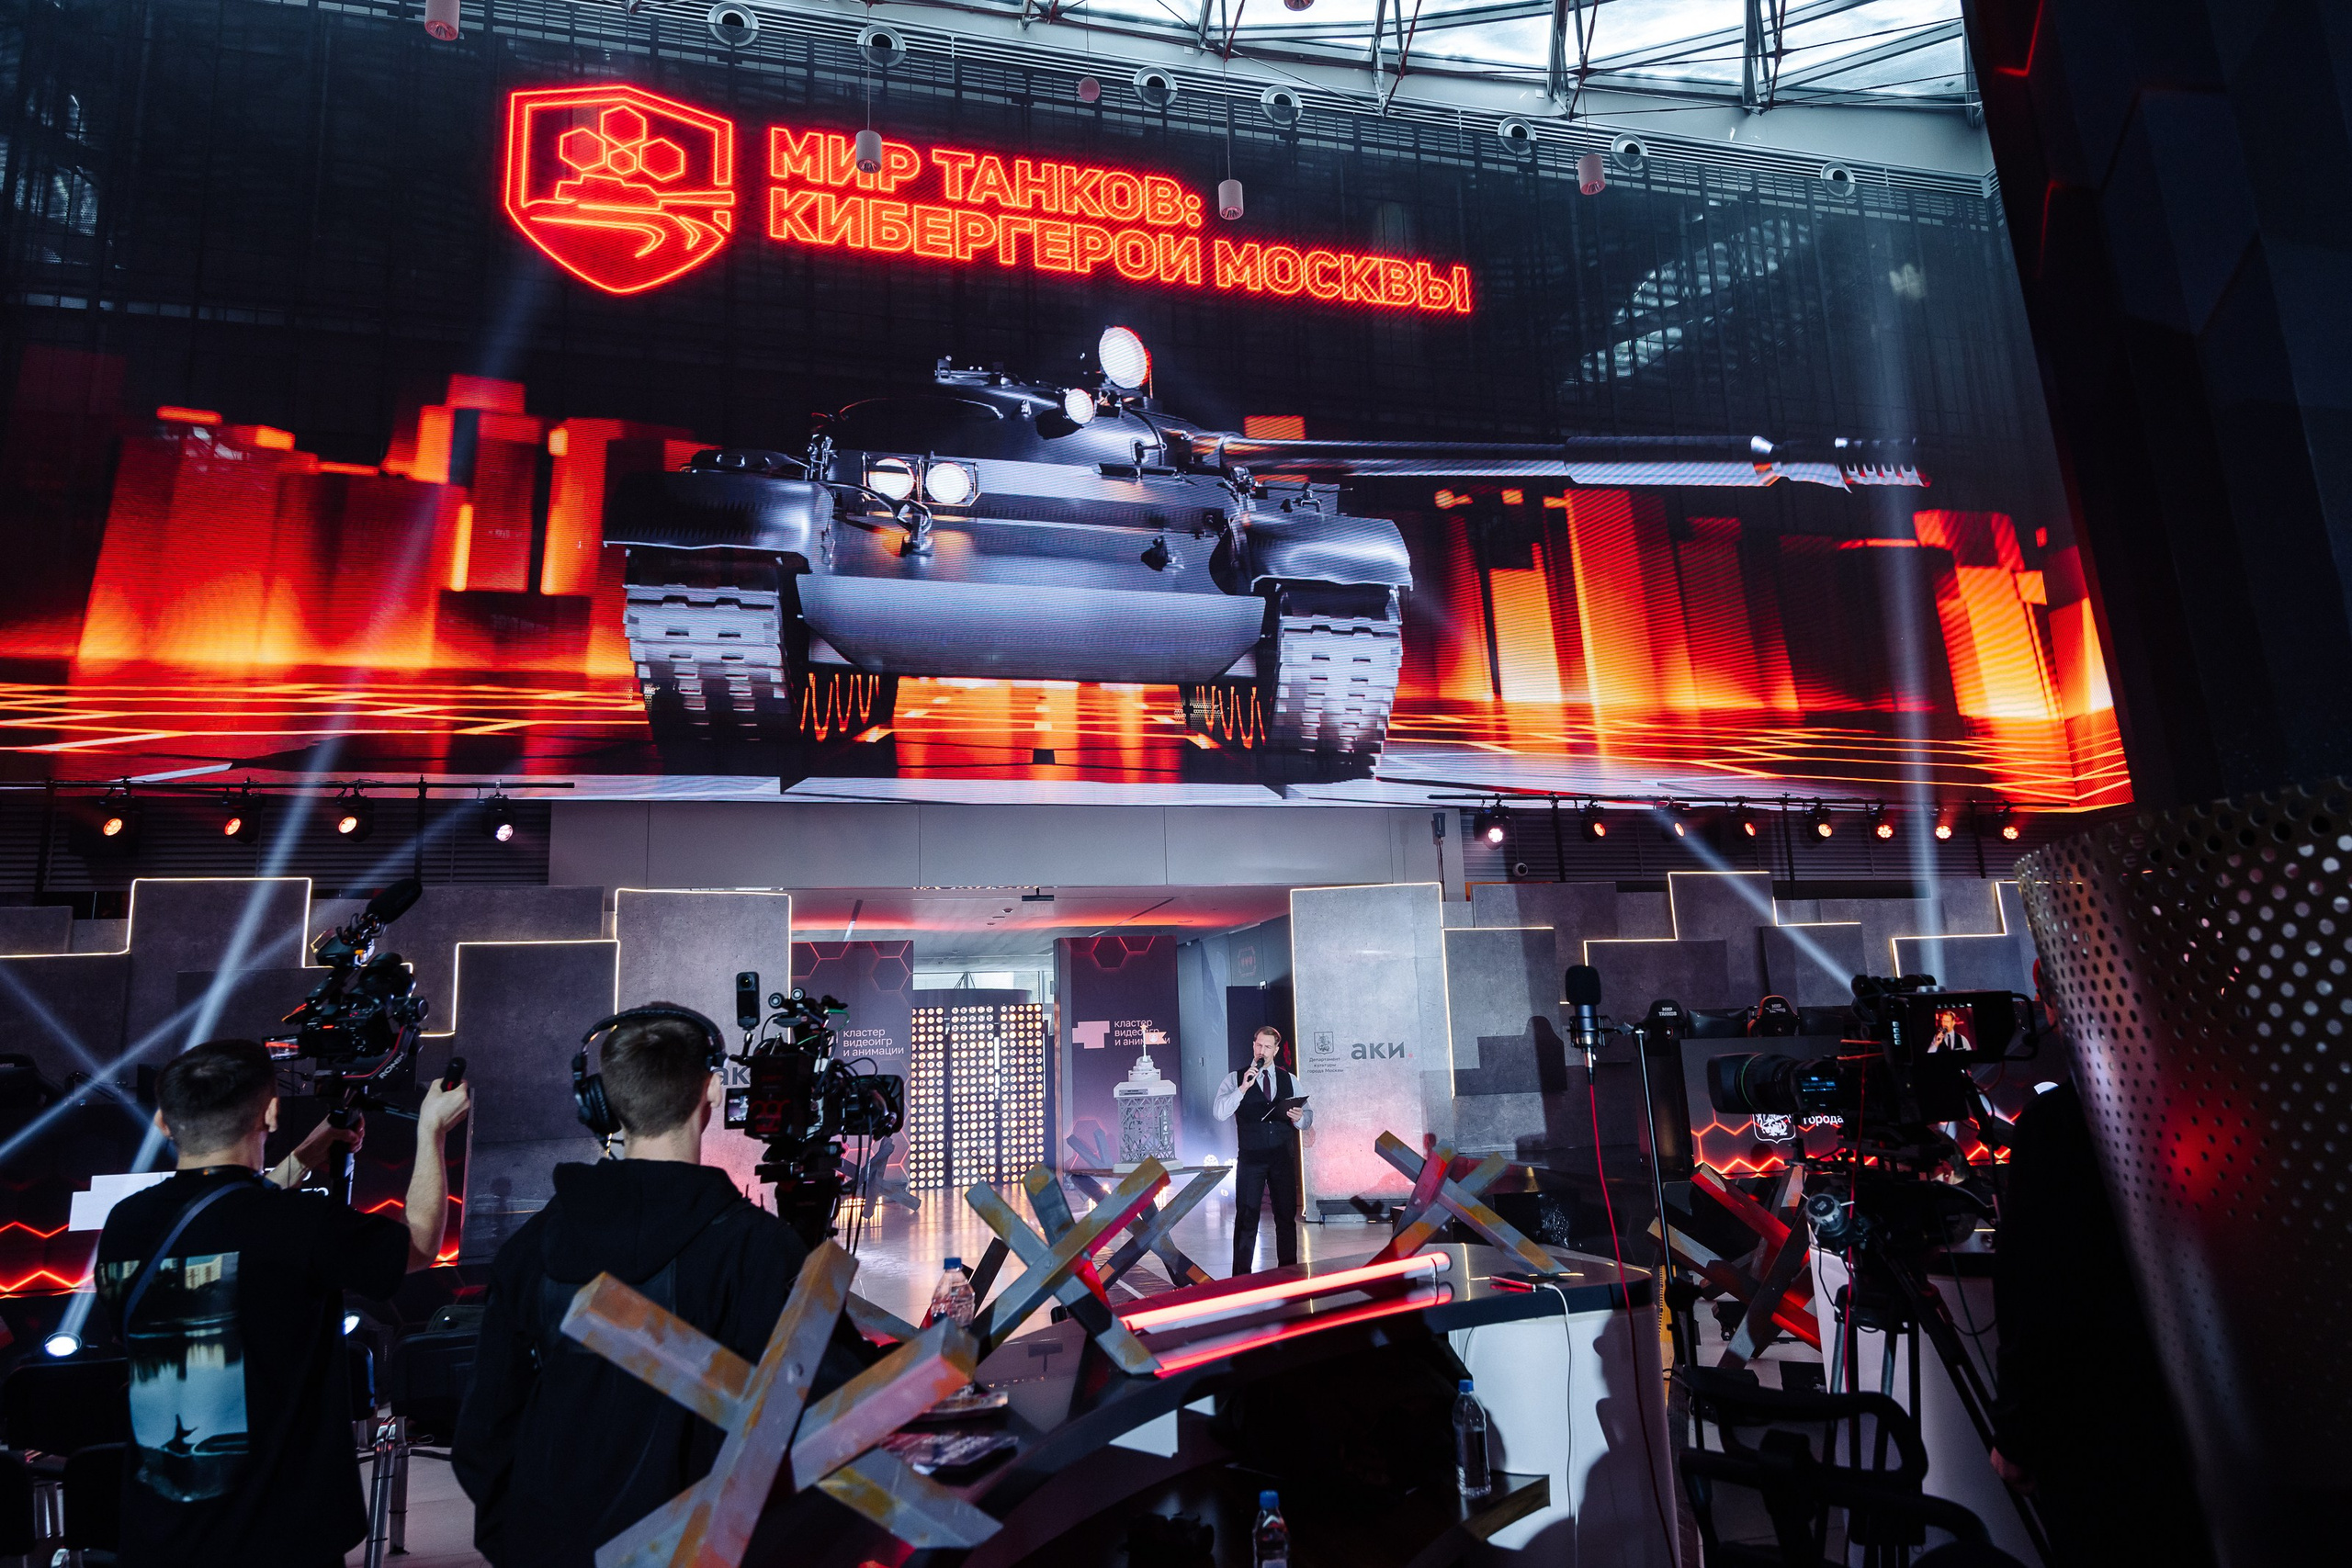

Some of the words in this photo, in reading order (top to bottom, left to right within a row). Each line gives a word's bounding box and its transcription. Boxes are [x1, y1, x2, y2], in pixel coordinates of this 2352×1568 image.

[770, 127, 921, 192] МИР
[932, 149, 1202, 228] ТАНКОВ:
[769, 187, 1202, 285] КИБЕРГЕРОИ
[1215, 239, 1470, 312] МОСКВЫ
[843, 1029, 886, 1038] кластер
[843, 1038, 893, 1047] видеоигр
[852, 1047, 904, 1056] анимации
[379, 1051, 404, 1079] RONIN
[1803, 1115, 1844, 1126] города
